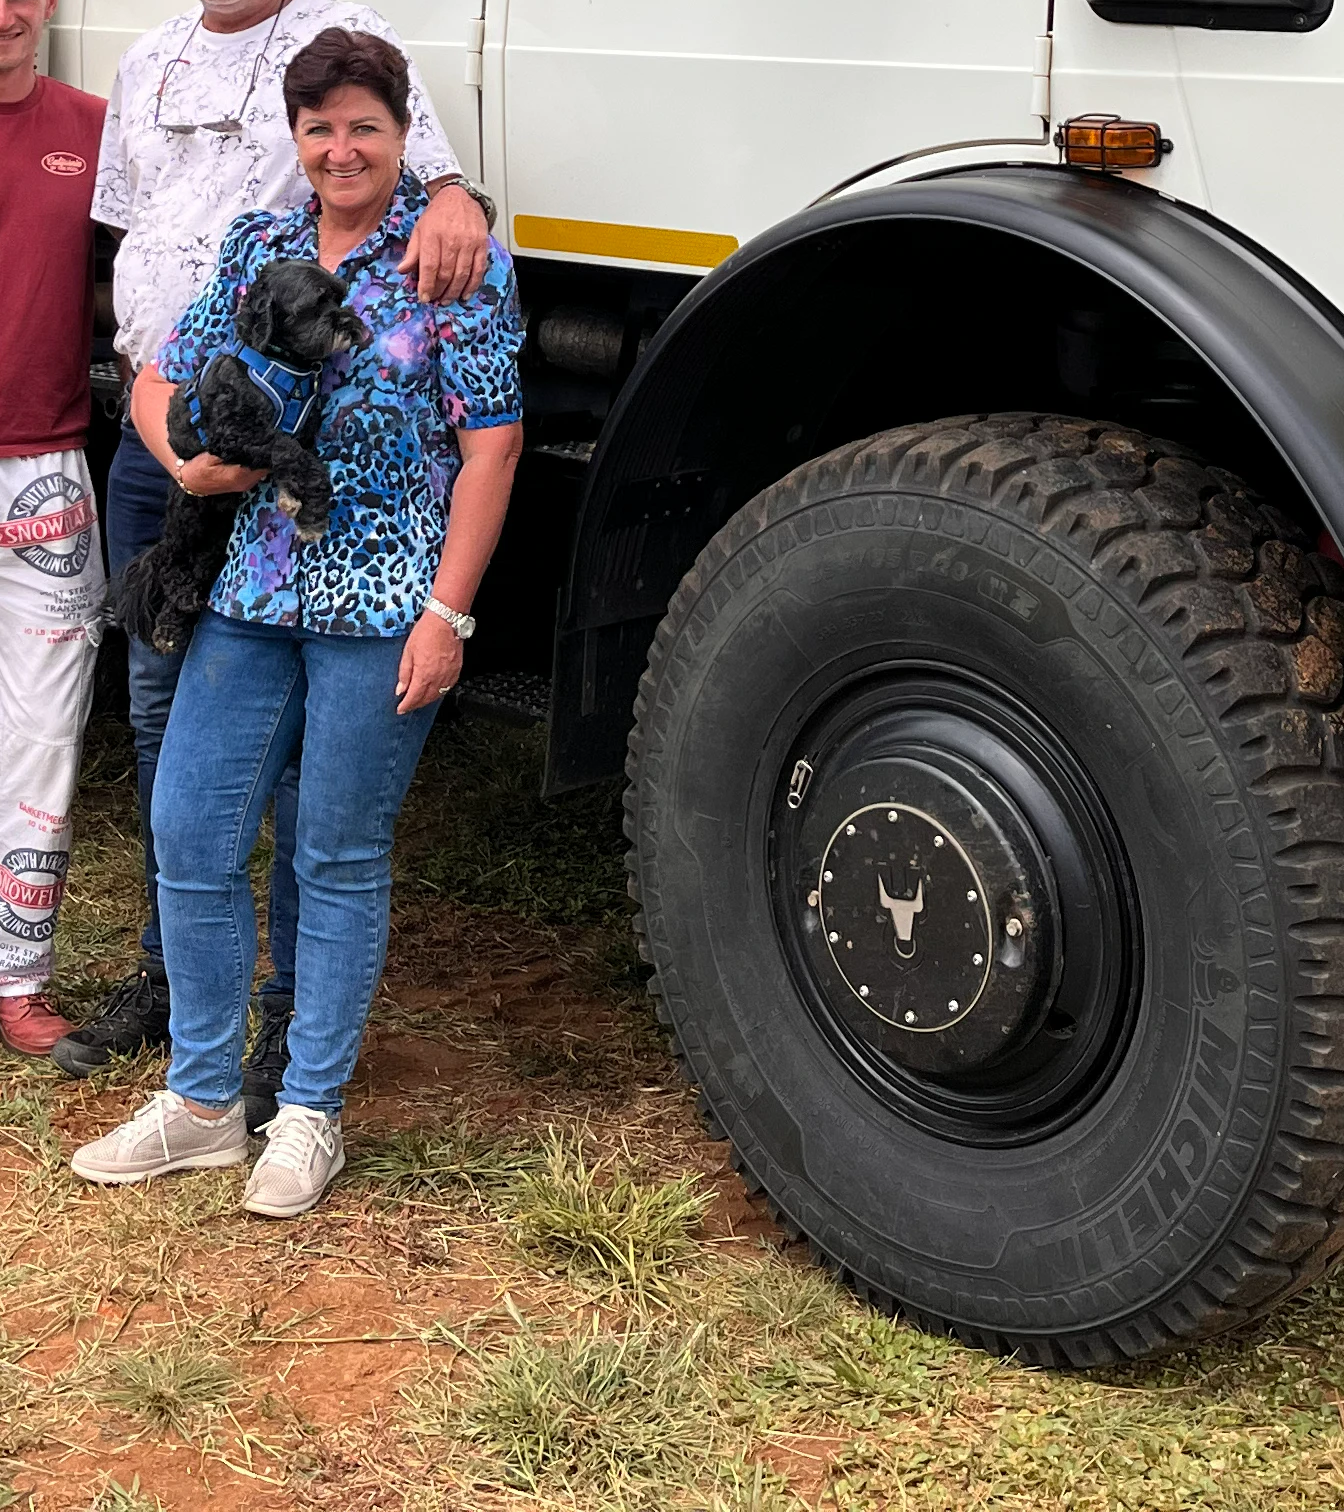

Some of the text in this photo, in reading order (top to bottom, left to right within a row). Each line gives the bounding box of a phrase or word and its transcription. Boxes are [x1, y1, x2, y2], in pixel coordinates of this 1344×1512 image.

[13, 480, 49, 517] SOUTH
[22, 546, 70, 573] MILLING
[7, 852, 37, 873] SOUTH
[1034, 1007, 1239, 1282] MICHELIN
